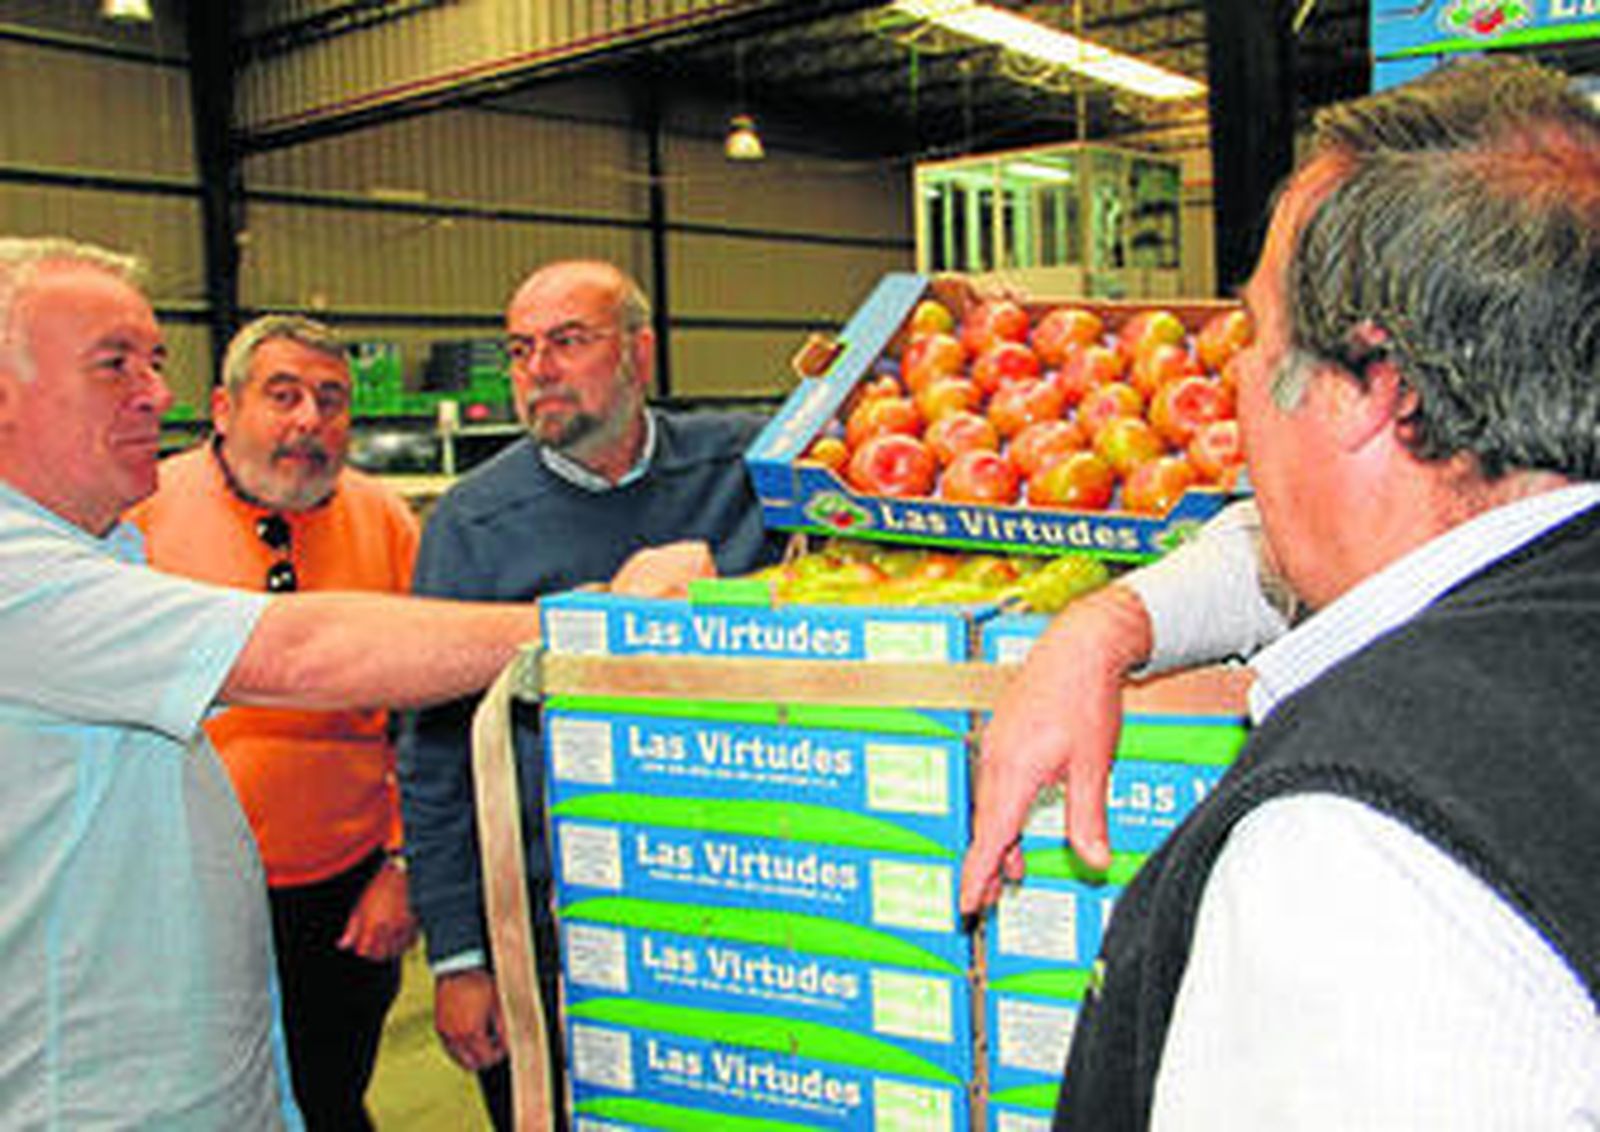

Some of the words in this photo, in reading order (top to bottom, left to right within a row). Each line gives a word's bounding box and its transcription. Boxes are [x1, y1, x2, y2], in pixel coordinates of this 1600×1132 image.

[880, 504, 947, 534] Las
[958, 510, 1139, 548] Virtudes
[624, 612, 681, 647] Las
[693, 616, 850, 653] Virtudes
[628, 725, 685, 760] Las
[698, 731, 853, 775] Virtudes
[637, 834, 693, 868] Las
[704, 842, 858, 889] Virtudes
[642, 936, 697, 973] Las
[707, 947, 858, 998] Virtudes
[648, 1040, 701, 1074] Las
[712, 1052, 860, 1105] Virtudes
